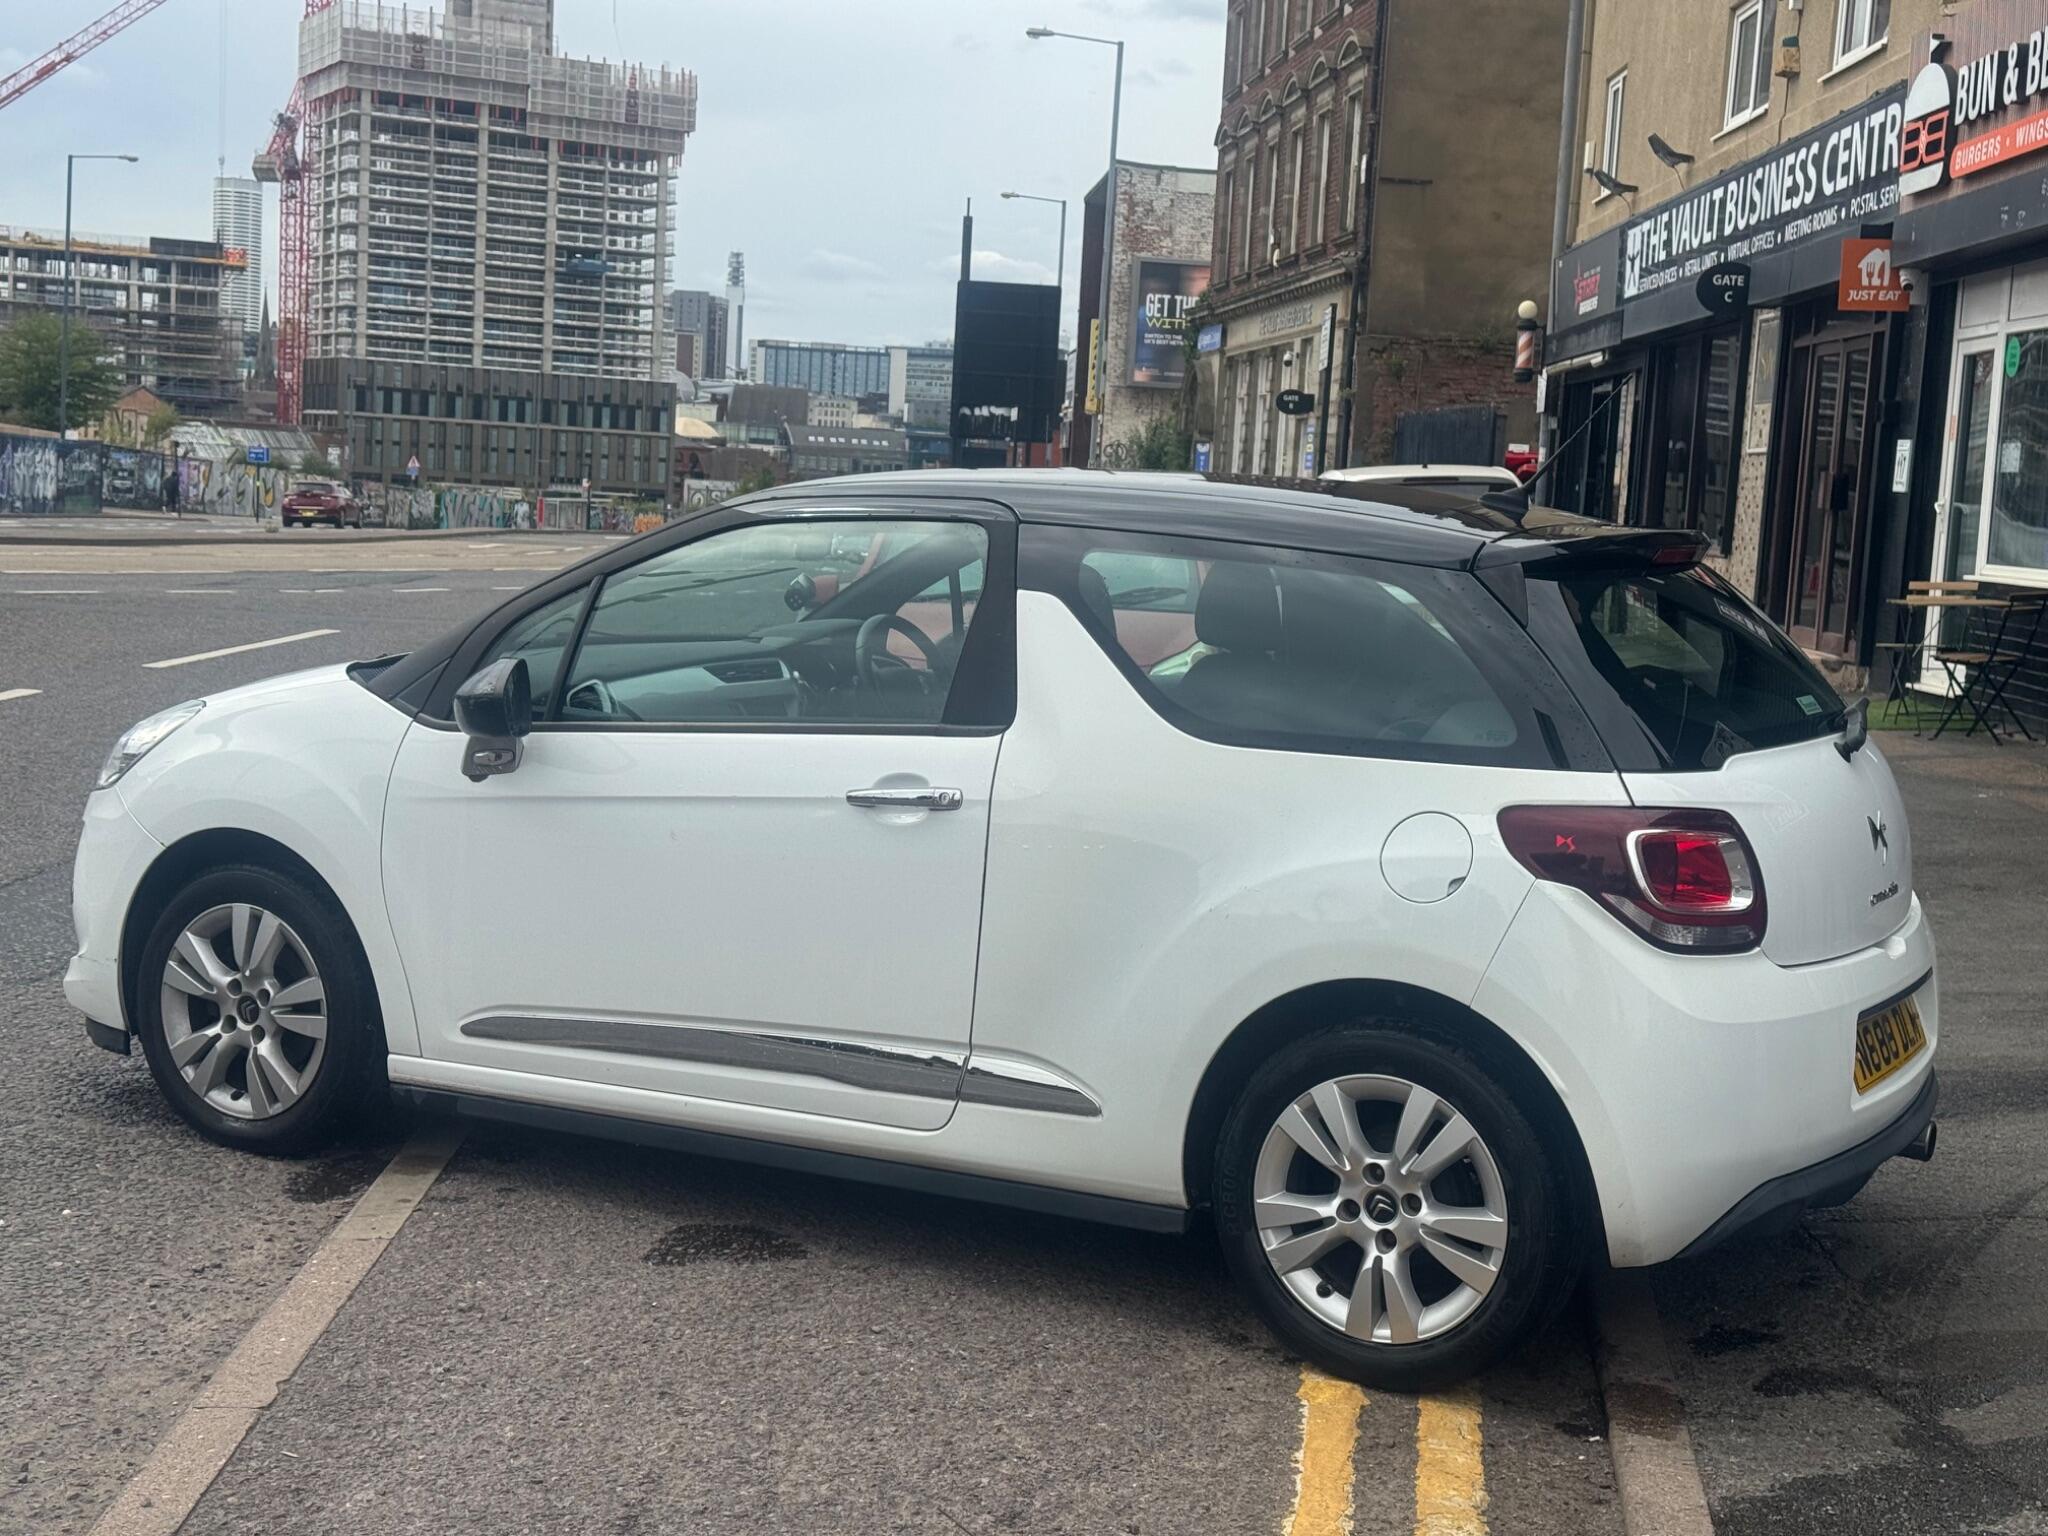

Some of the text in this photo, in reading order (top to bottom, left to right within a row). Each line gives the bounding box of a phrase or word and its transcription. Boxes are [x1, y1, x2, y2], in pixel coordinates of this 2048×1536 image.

[1954, 50, 1999, 126] BUN
[2003, 41, 2019, 106] &
[1955, 135, 2001, 171] BURGERS
[1640, 211, 1669, 268] THE
[1672, 186, 1725, 256] VAULT
[1724, 141, 1820, 236] BUSINESS
[1727, 239, 1750, 262] VIRTUAL
[1750, 230, 1775, 256] OFFICES
[1784, 214, 1812, 242] MEETING
[1812, 205, 1838, 231] ROOMS
[1850, 191, 1879, 219] POSTAL
[1712, 274, 1745, 287] GATE
[1145, 292, 1171, 318] GET
[1724, 291, 1733, 303] C
[1847, 289, 1902, 302] JUST EAT
[1282, 394, 1299, 402] GATE
